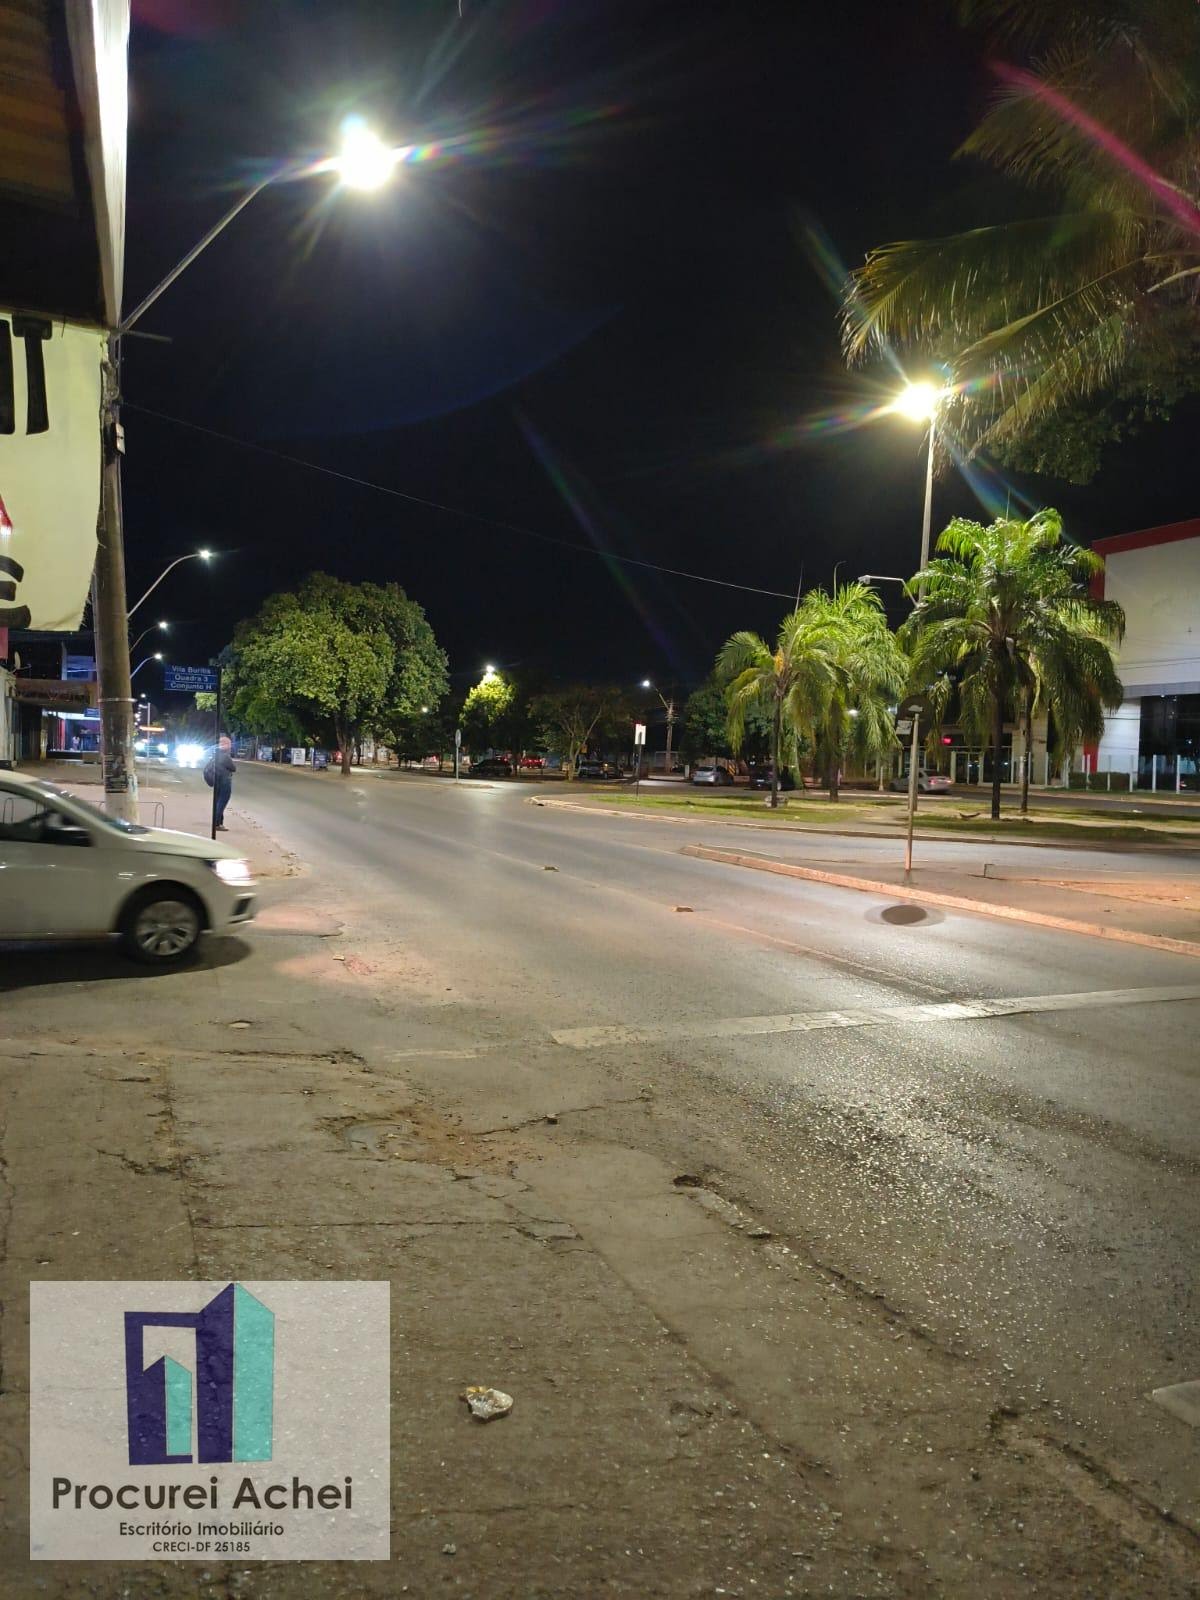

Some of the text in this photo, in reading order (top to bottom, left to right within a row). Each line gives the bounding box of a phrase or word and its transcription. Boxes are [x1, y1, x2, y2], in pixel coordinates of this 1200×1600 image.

[171, 665, 186, 673] Vila
[174, 674, 202, 682] Quadra
[170, 682, 204, 691] Conjunto
